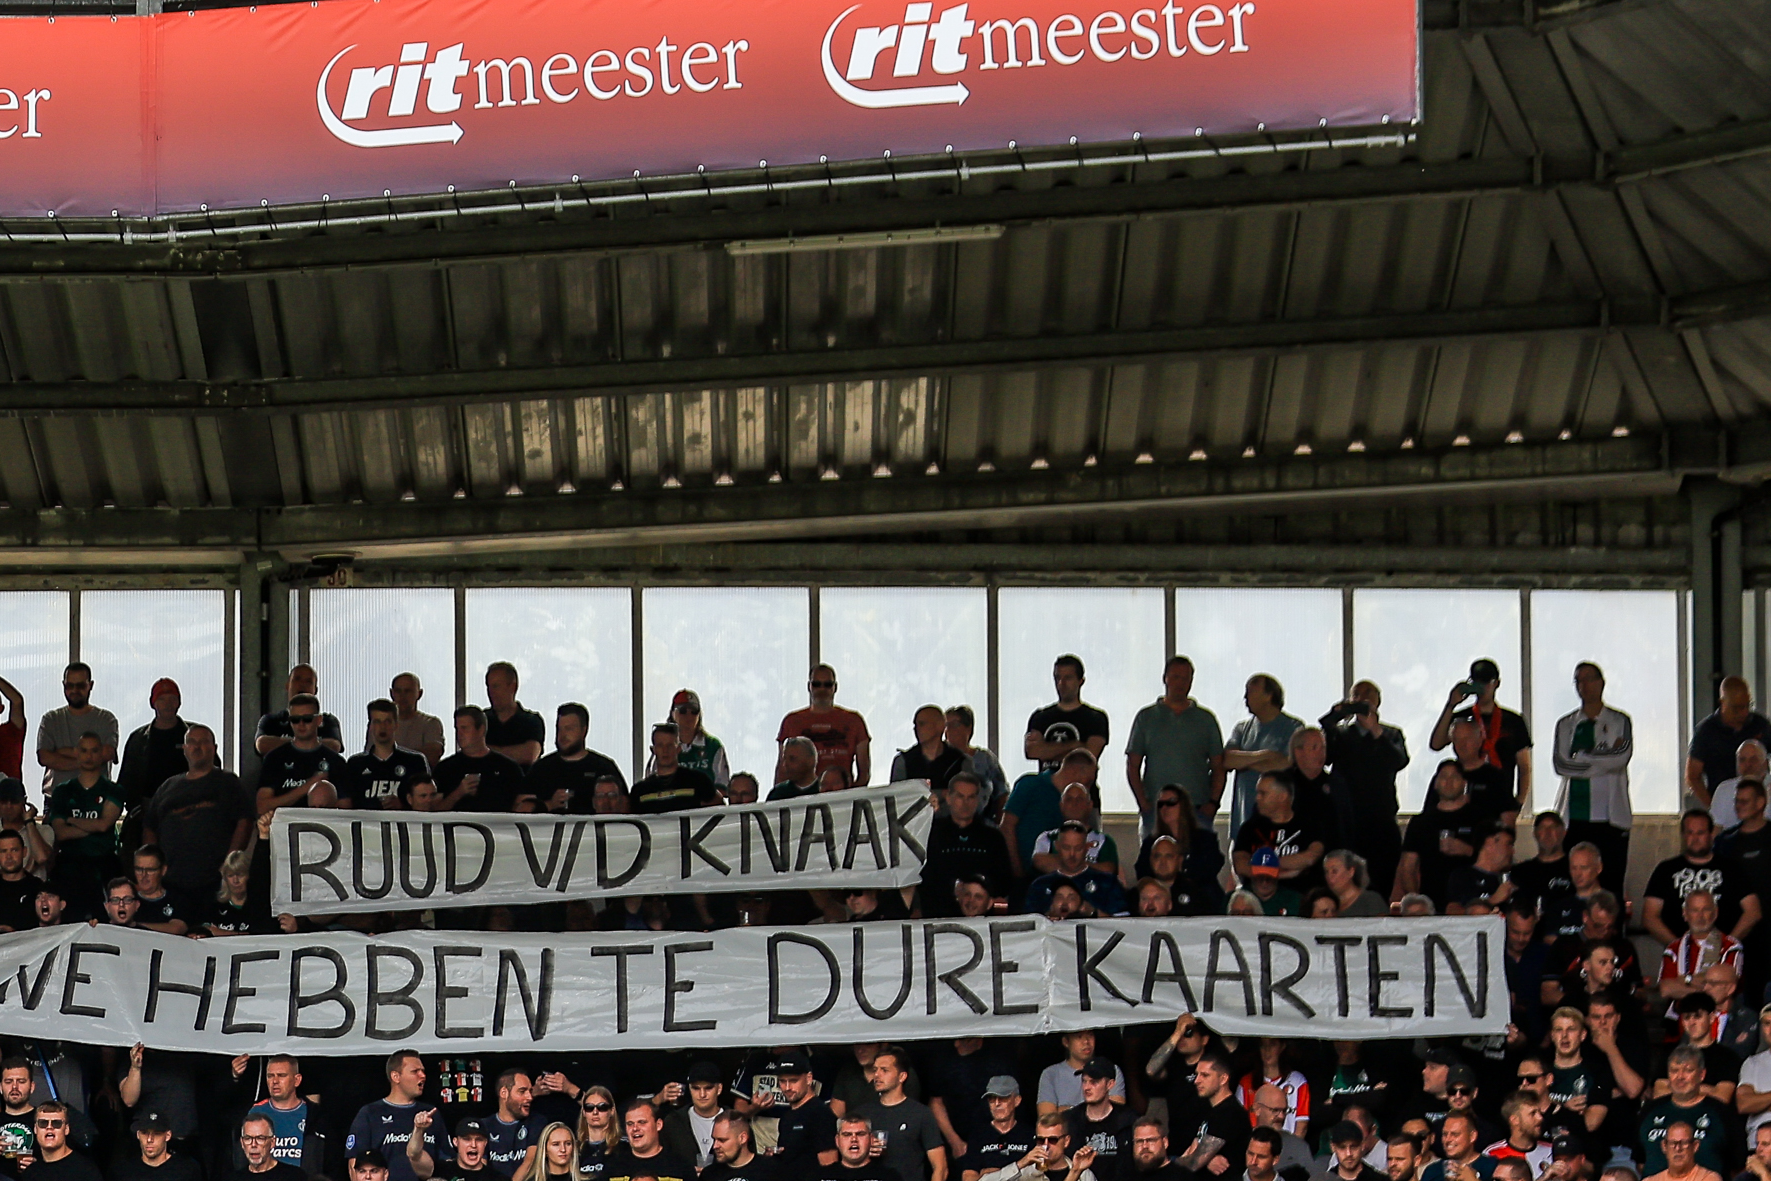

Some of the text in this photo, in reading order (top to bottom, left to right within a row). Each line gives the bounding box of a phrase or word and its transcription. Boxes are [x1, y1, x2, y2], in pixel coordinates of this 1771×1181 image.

[341, 35, 748, 120] ritmeester
[846, 0, 1255, 82] ritmeester
[289, 819, 493, 902] RUUD
[681, 788, 927, 880] KNAAK
[145, 944, 556, 1042] HEBBEN
[590, 940, 717, 1034] TE
[767, 919, 1044, 1027] DURE
[1076, 923, 1489, 1019] KAARTEN
